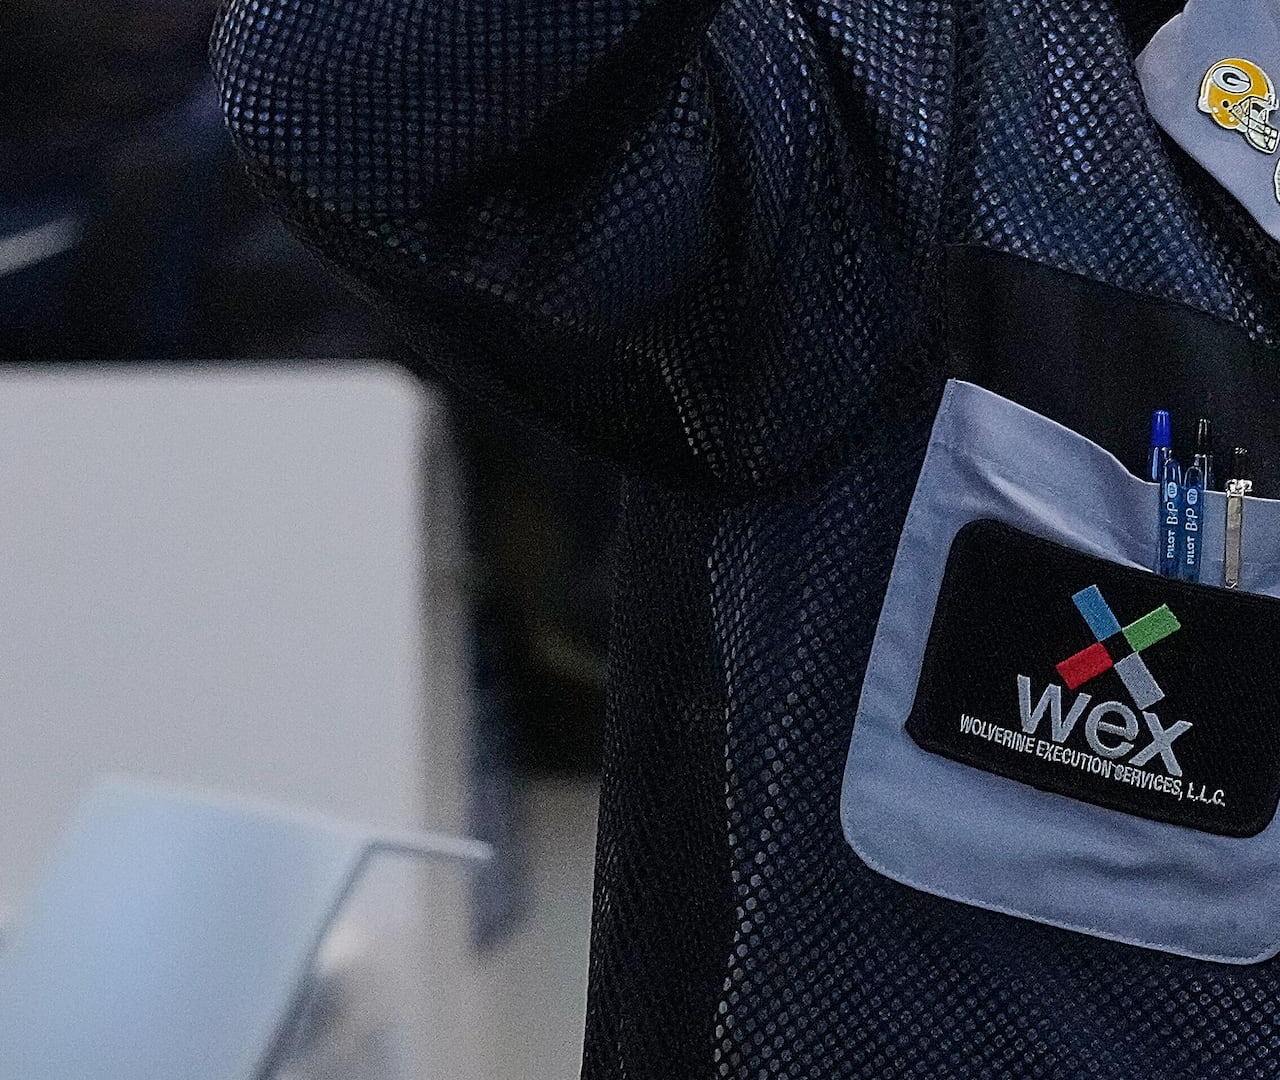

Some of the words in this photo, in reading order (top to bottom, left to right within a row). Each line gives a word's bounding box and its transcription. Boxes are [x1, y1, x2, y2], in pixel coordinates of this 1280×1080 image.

[1166, 530, 1176, 559] PILOT
[1186, 536, 1195, 565] PILOT
[1017, 674, 1193, 777] wex
[960, 714, 1035, 754] WOLVERINE
[1036, 740, 1113, 778] EXECUTION
[1114, 764, 1183, 801] SERVICES,
[1187, 782, 1225, 806] L.L.C.
